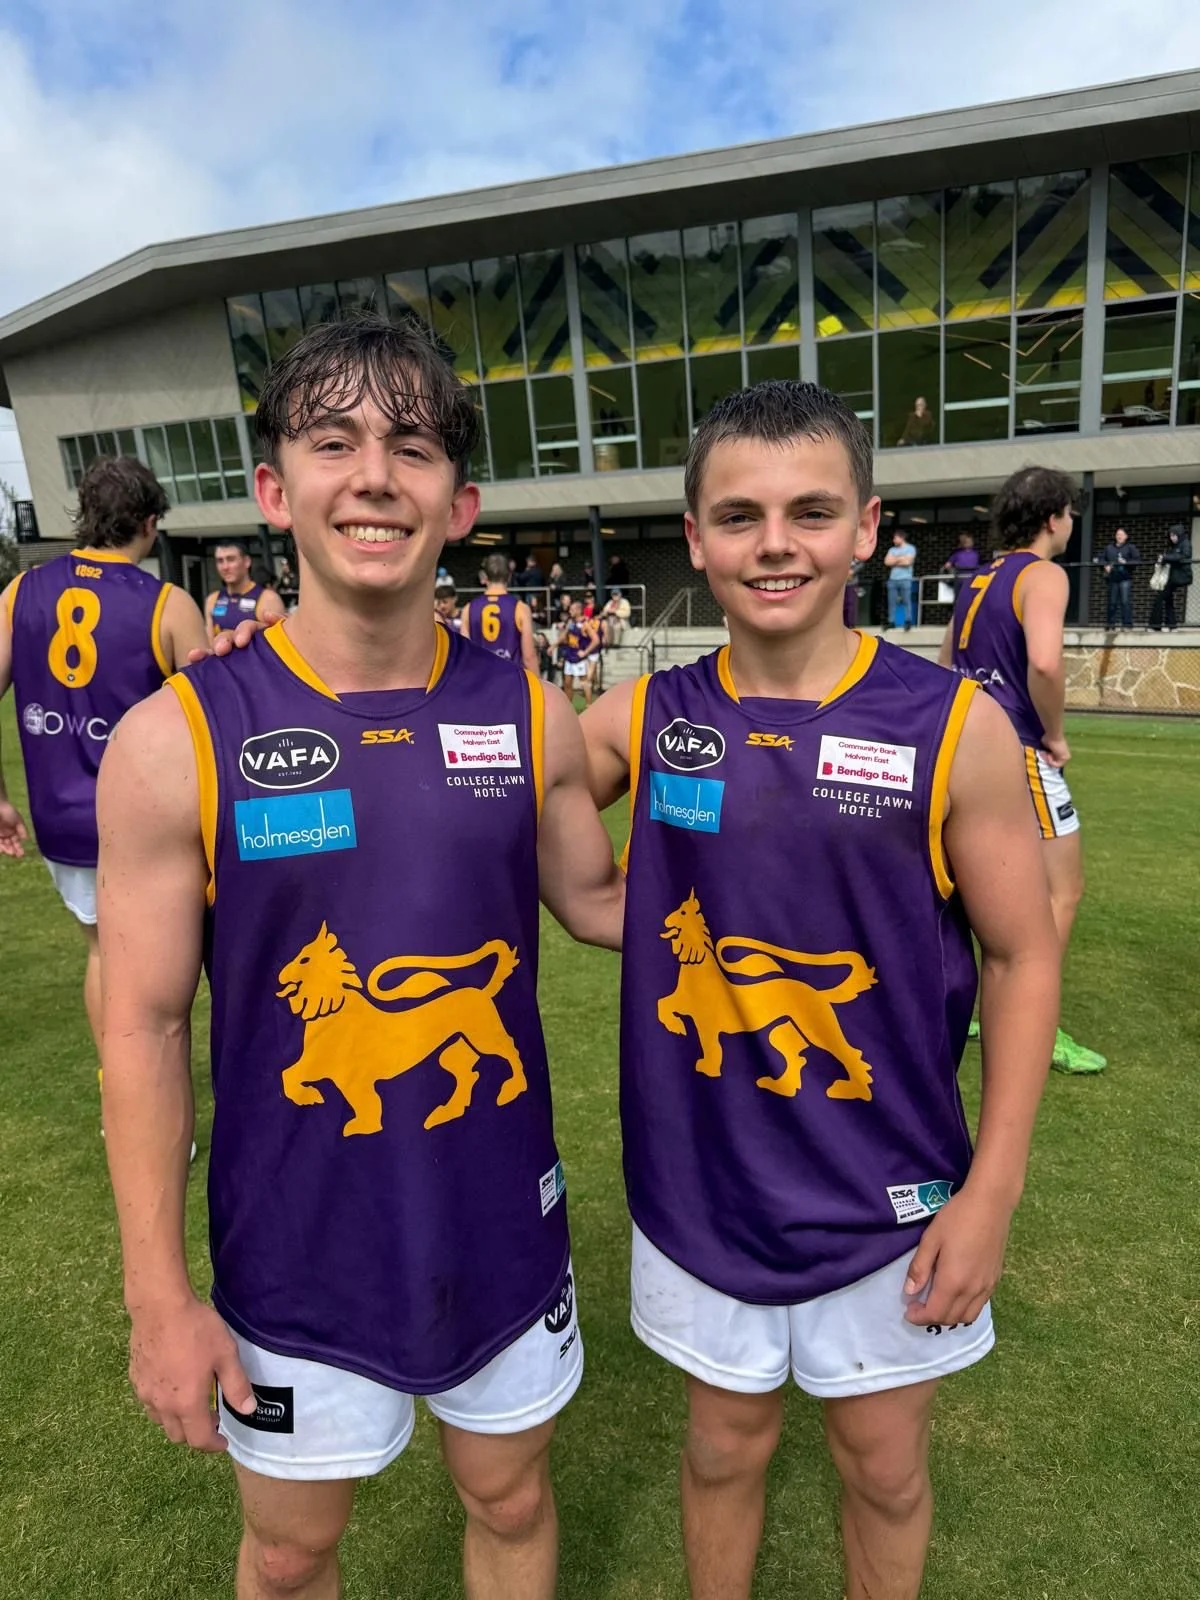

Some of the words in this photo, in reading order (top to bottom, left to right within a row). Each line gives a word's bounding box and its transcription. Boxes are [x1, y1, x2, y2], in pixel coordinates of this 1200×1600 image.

[958, 571, 996, 650] 7
[482, 604, 500, 642] 6
[48, 587, 101, 689] 8
[44, 711, 109, 741] OWC
[454, 728, 487, 737] Community
[664, 734, 718, 757] VAFA
[838, 741, 878, 754] Community
[879, 747, 897, 755] Bank
[244, 746, 331, 770] VAFA
[461, 752, 497, 763] Bendigo
[498, 752, 516, 761] Bank
[873, 756, 889, 764] East
[446, 776, 496, 786] COLLEGE
[499, 775, 525, 785] LAWN
[837, 765, 879, 780] Bendigo
[881, 771, 908, 783] Bank
[474, 787, 507, 798] HOTEL
[812, 787, 871, 804] COLLEGE
[875, 795, 913, 810] LAWN
[654, 783, 716, 826] holmesglen
[838, 803, 882, 818] HOTEL
[241, 797, 351, 849] holmesglen
[891, 1189, 916, 1200] SSA
[256, 1406, 281, 1417] son
